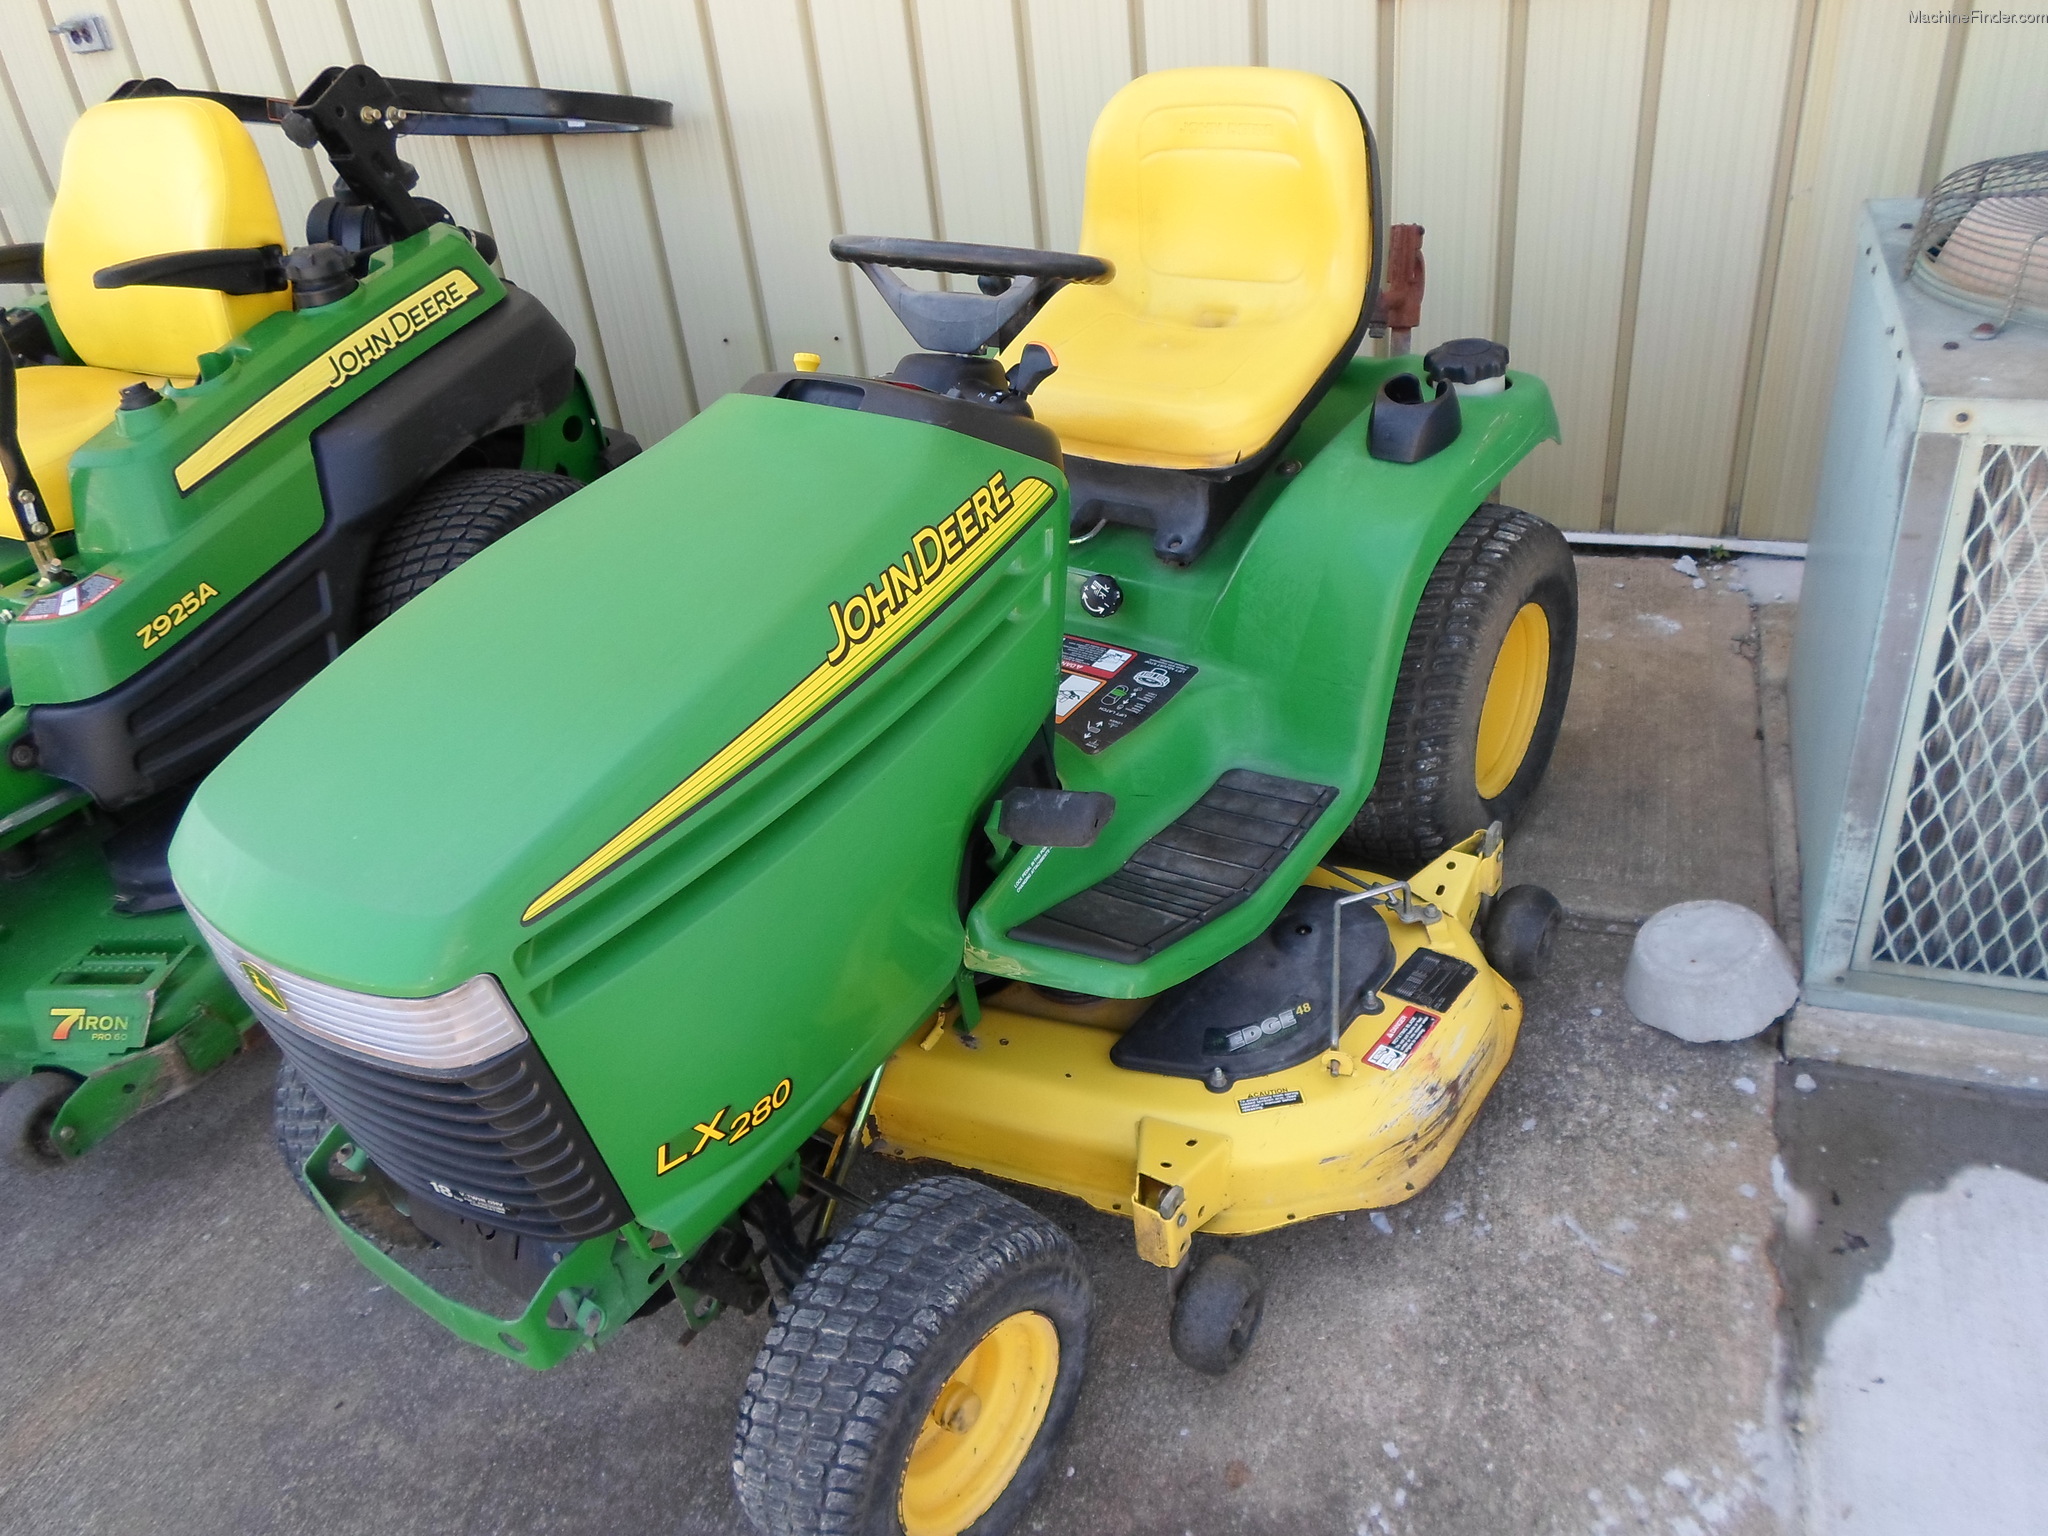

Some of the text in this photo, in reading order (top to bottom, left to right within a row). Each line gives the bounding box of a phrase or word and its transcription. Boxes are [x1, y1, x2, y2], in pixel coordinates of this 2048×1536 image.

[327, 280, 467, 388] JOHN DEERE
[826, 469, 1015, 667] JOHN DEERE
[136, 581, 219, 650] Z925A
[50, 1008, 129, 1040] 7 IRON
[91, 1033, 128, 1041] PRO 60
[1226, 1002, 1312, 1052] EDGE 48
[1389, 1015, 1408, 1034] DANGER
[1253, 1087, 1288, 1098] CAUTION
[656, 1078, 793, 1177] LX280
[429, 1181, 453, 1198] 18
